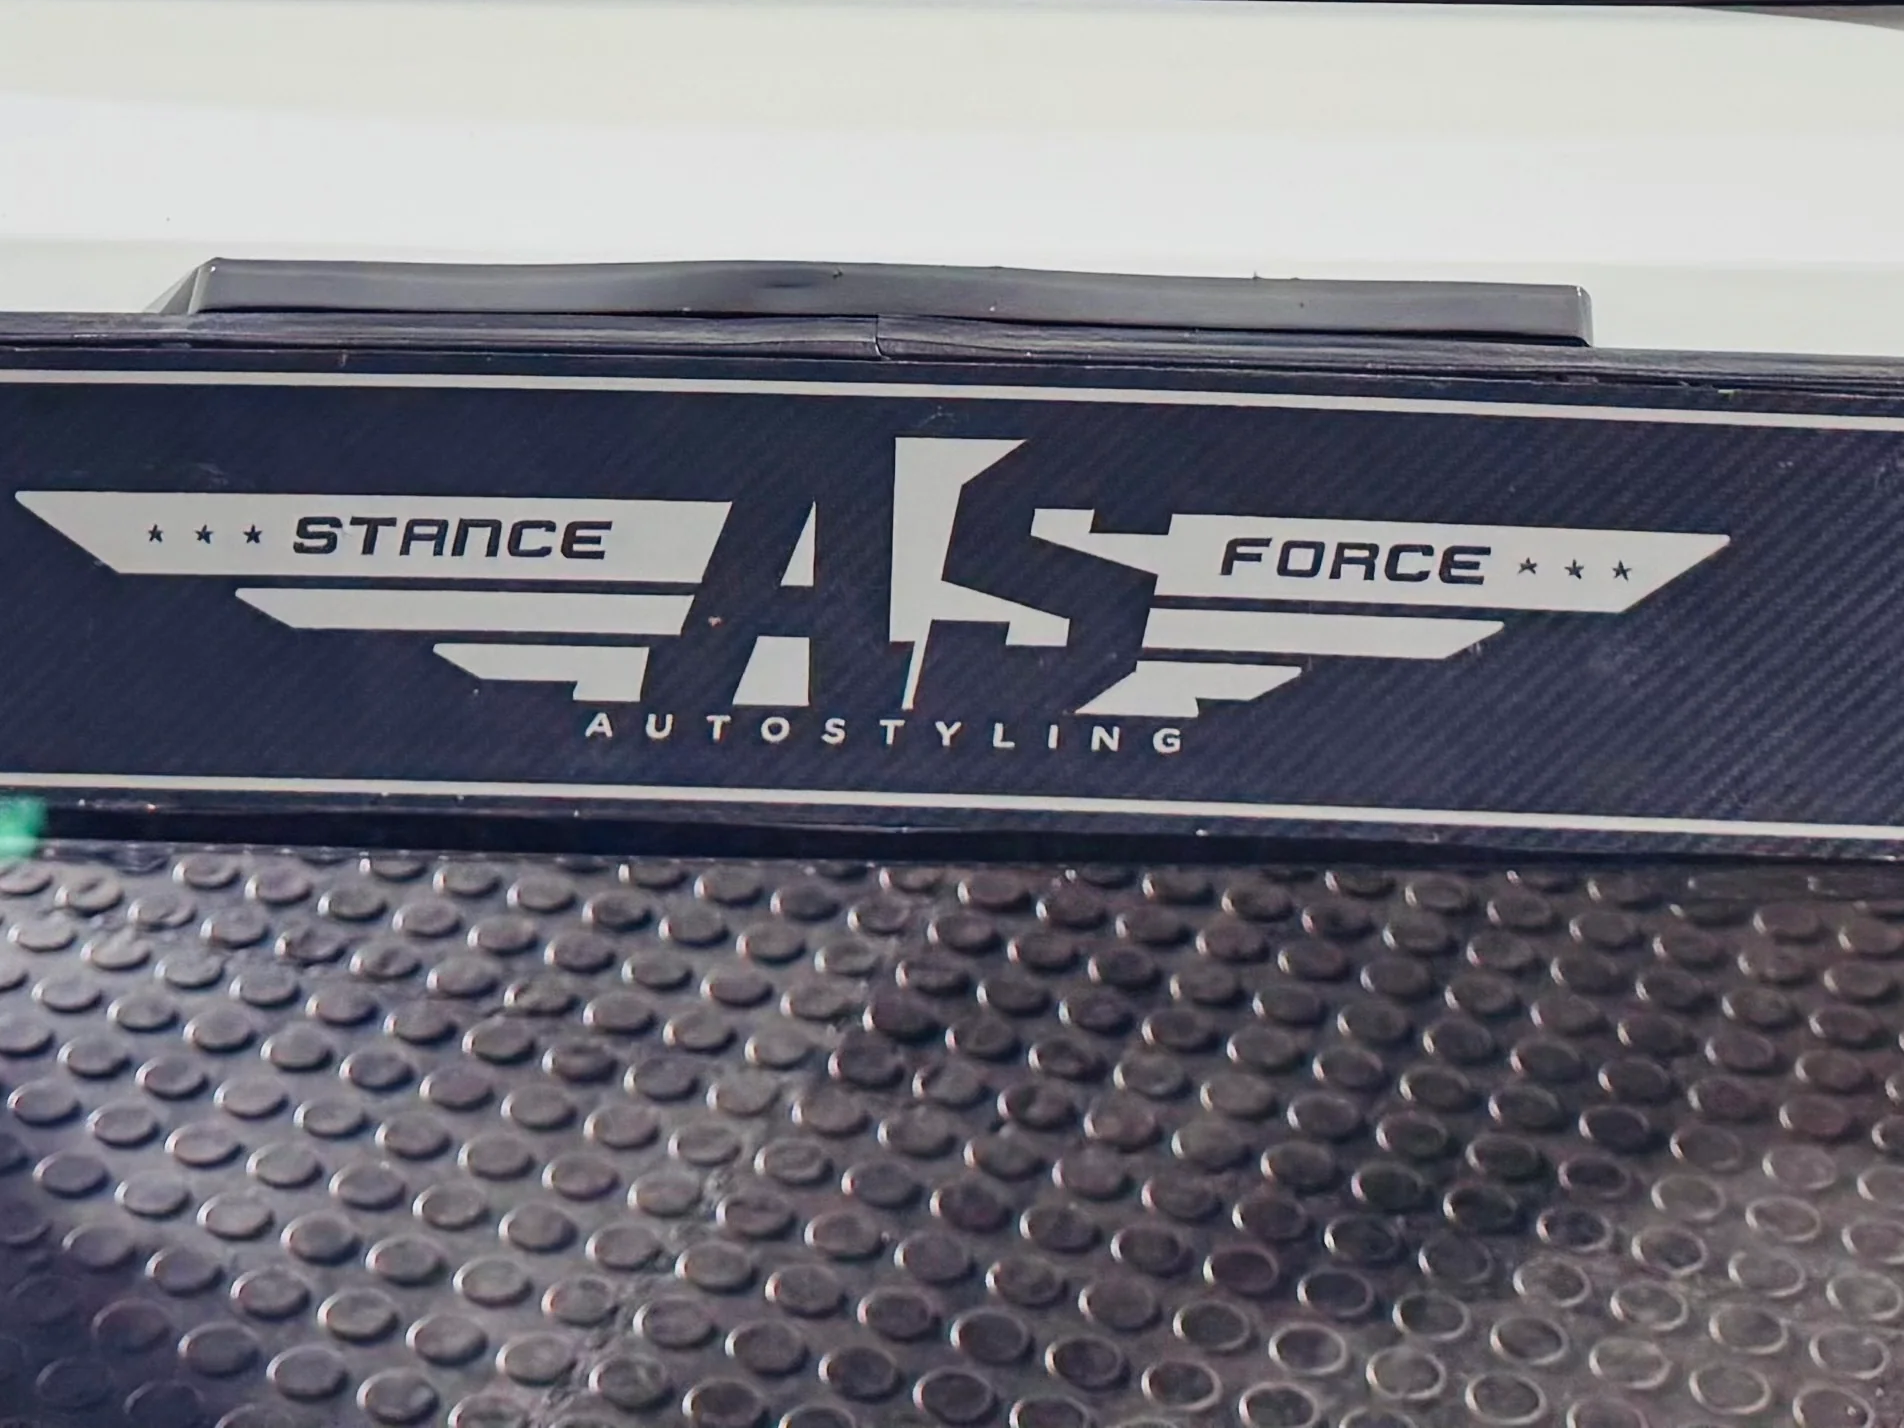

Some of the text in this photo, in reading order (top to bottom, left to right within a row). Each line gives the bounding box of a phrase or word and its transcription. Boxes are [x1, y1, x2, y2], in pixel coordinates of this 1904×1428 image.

[293, 516, 1492, 585] STANCE FORCE
[585, 712, 1183, 754] AUTOSTYLING
